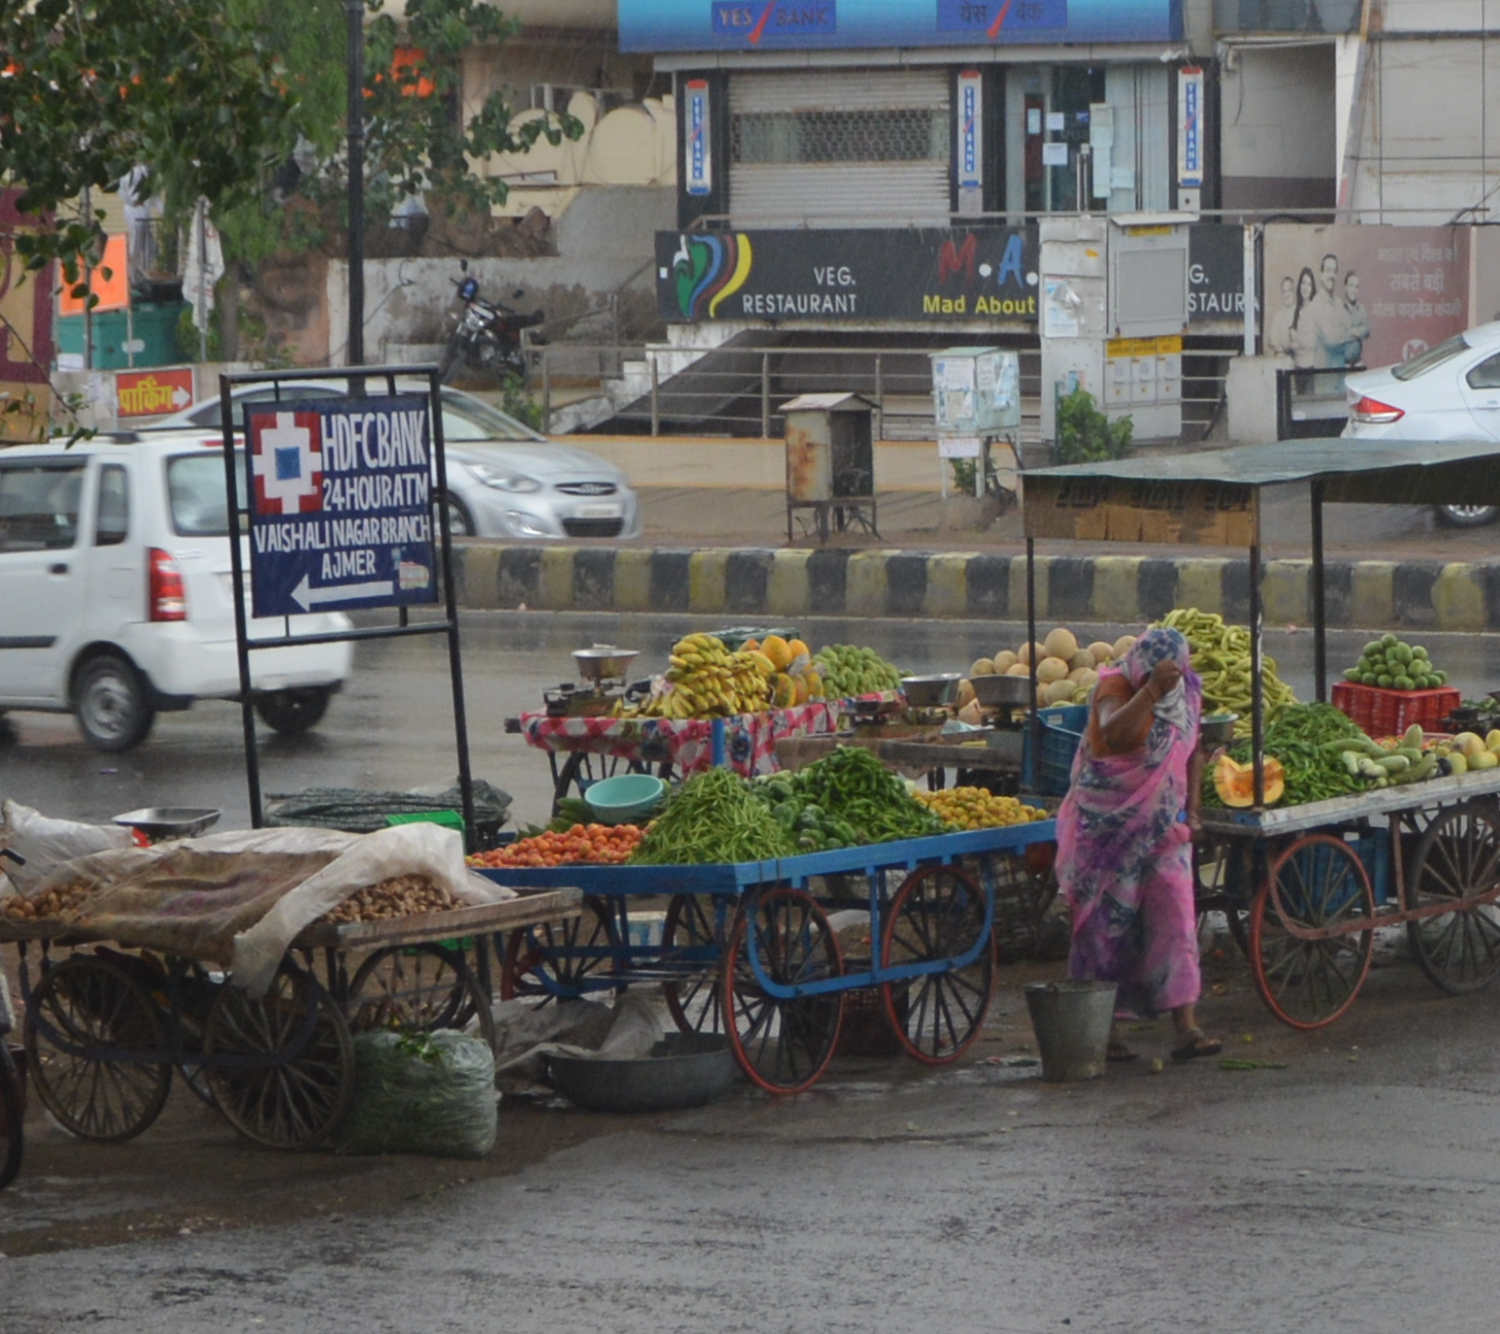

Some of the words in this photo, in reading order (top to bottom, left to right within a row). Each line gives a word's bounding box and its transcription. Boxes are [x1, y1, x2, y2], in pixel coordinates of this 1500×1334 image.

[720, 8, 753, 27] YES
[776, 8, 828, 28] BANK
[814, 266, 856, 286] VEG.
[743, 294, 857, 314] RESTAURANT
[923, 295, 966, 314] Mad
[975, 295, 1036, 315] About
[118, 374, 173, 413] पार्किंग
[321, 414, 377, 472] HDFC
[378, 410, 427, 467] BANK
[322, 480, 344, 511] 24
[393, 473, 429, 505] ATM
[253, 521, 330, 553] VAISHALI
[333, 518, 380, 546] NAGAR
[381, 515, 430, 543] BRANCH
[321, 550, 376, 579] AJMER
